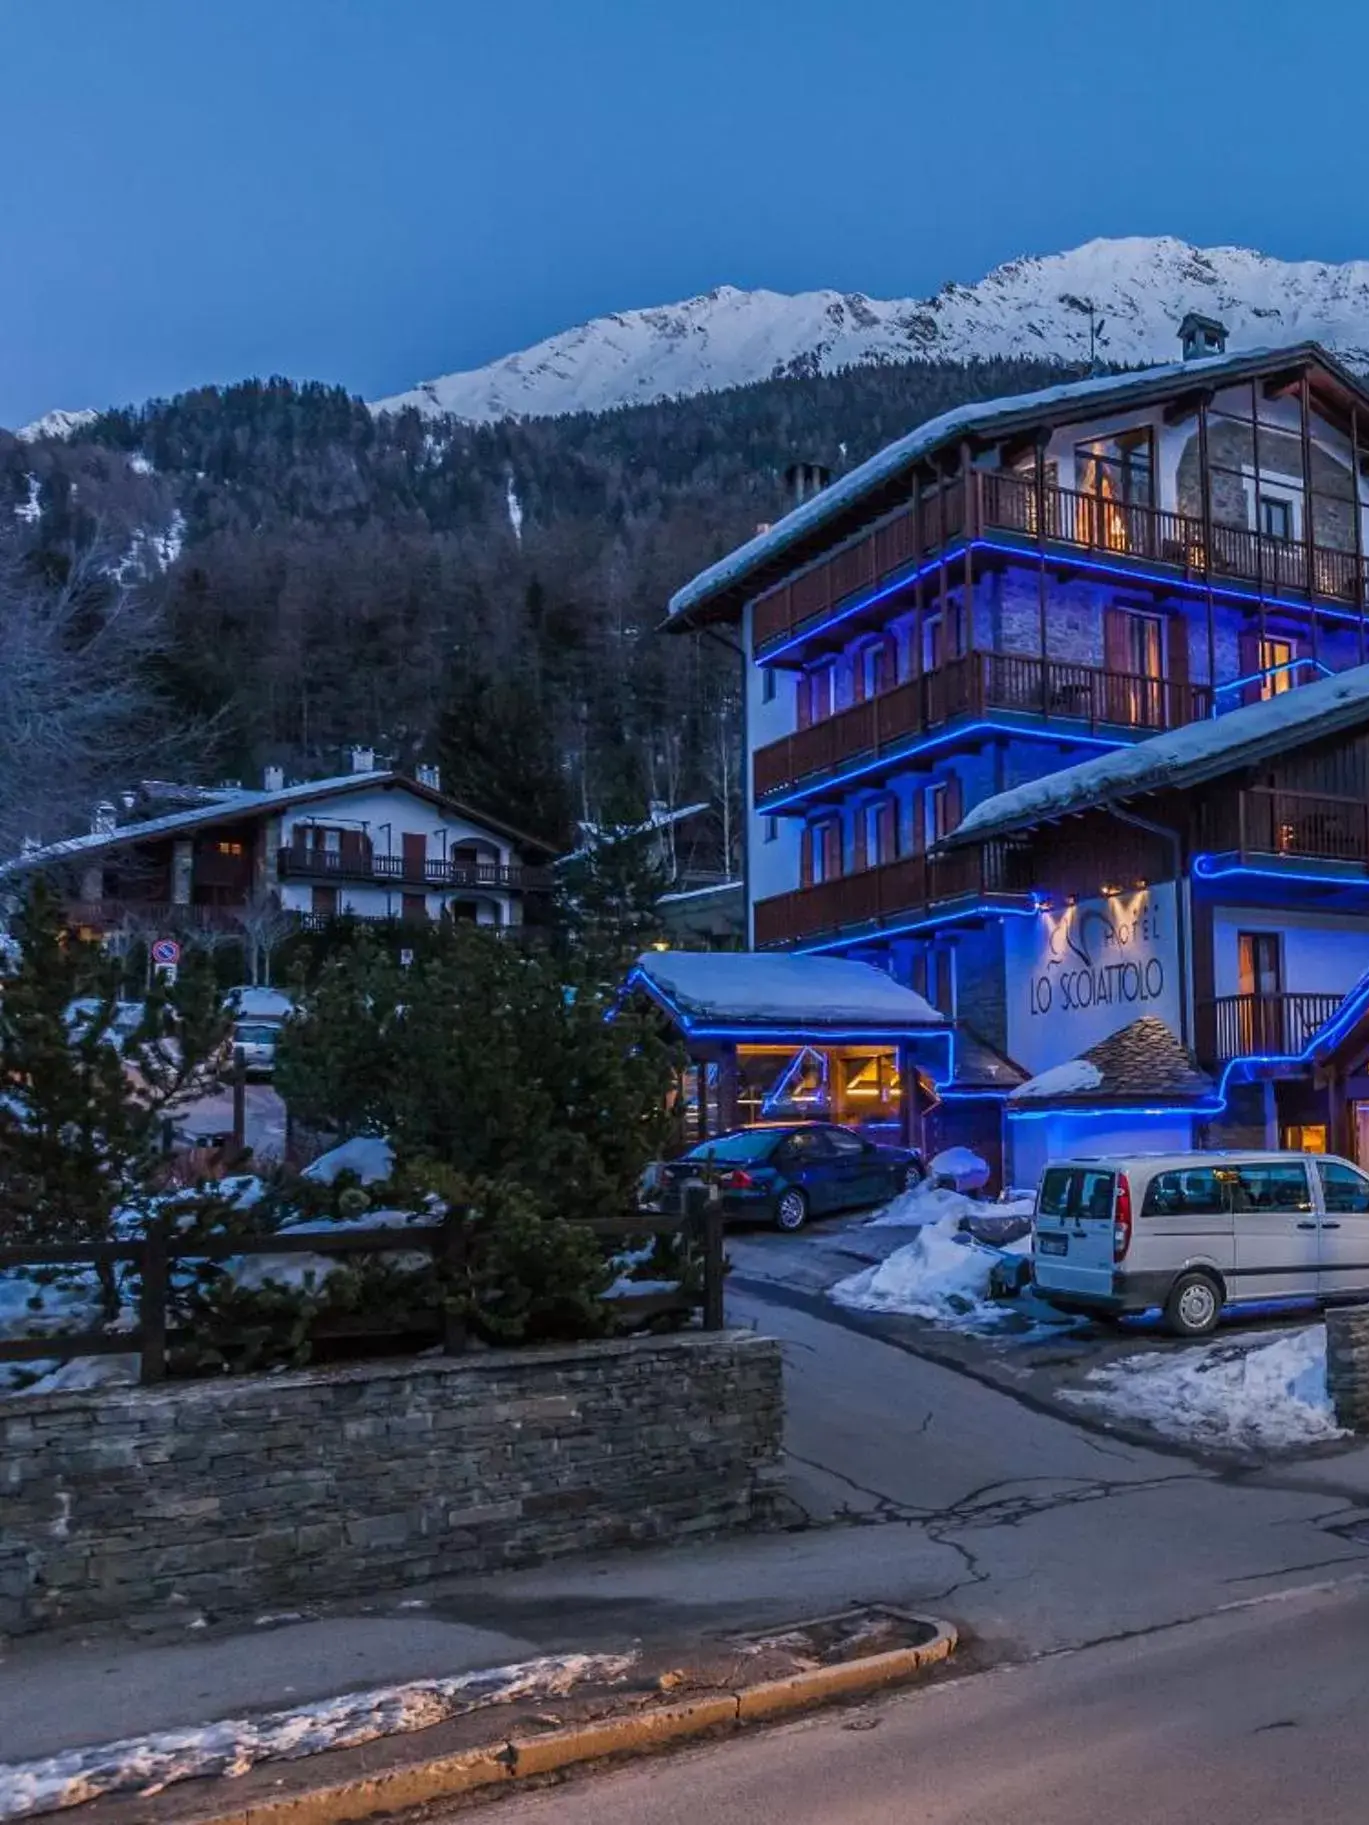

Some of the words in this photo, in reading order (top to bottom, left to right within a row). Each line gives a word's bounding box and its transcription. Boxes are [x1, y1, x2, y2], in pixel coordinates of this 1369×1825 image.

[1103, 915, 1160, 947] HOTEL
[1030, 975, 1052, 1015] LO
[1060, 957, 1164, 1011] SCOIATTOLO
